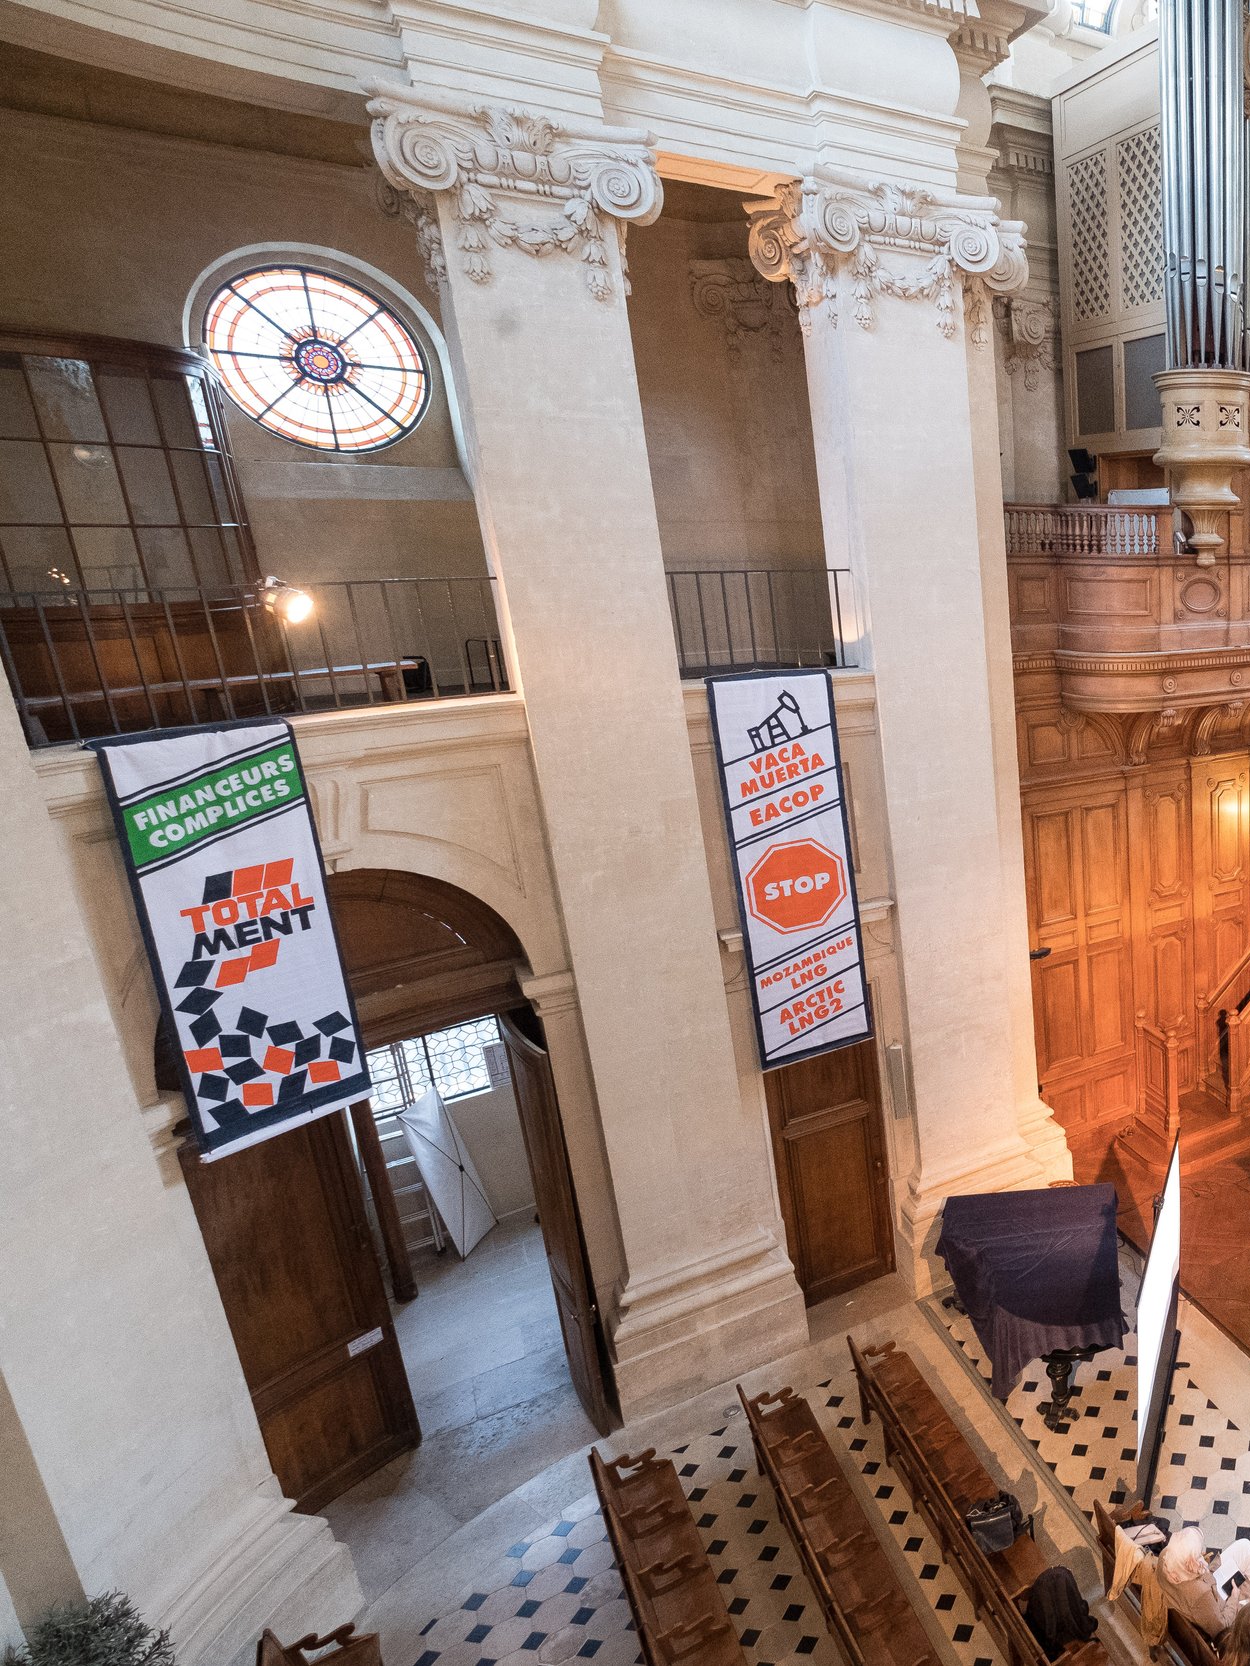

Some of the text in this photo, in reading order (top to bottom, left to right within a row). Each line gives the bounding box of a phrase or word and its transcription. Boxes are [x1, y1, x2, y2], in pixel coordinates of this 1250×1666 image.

[740, 756, 825, 798] MUERTA
[748, 743, 806, 775] VACA
[133, 754, 295, 831] FINANCEURS
[149, 778, 291, 848] COMPLICES
[749, 784, 825, 827] EACOP
[180, 883, 315, 934] TOTAL
[764, 871, 830, 902] STOP
[192, 904, 316, 961] MENT
[759, 935, 854, 989] MOZAMBIQUE
[790, 964, 828, 990] LNG
[779, 979, 845, 1024] ARCTIC
[788, 998, 844, 1037] LNG2
